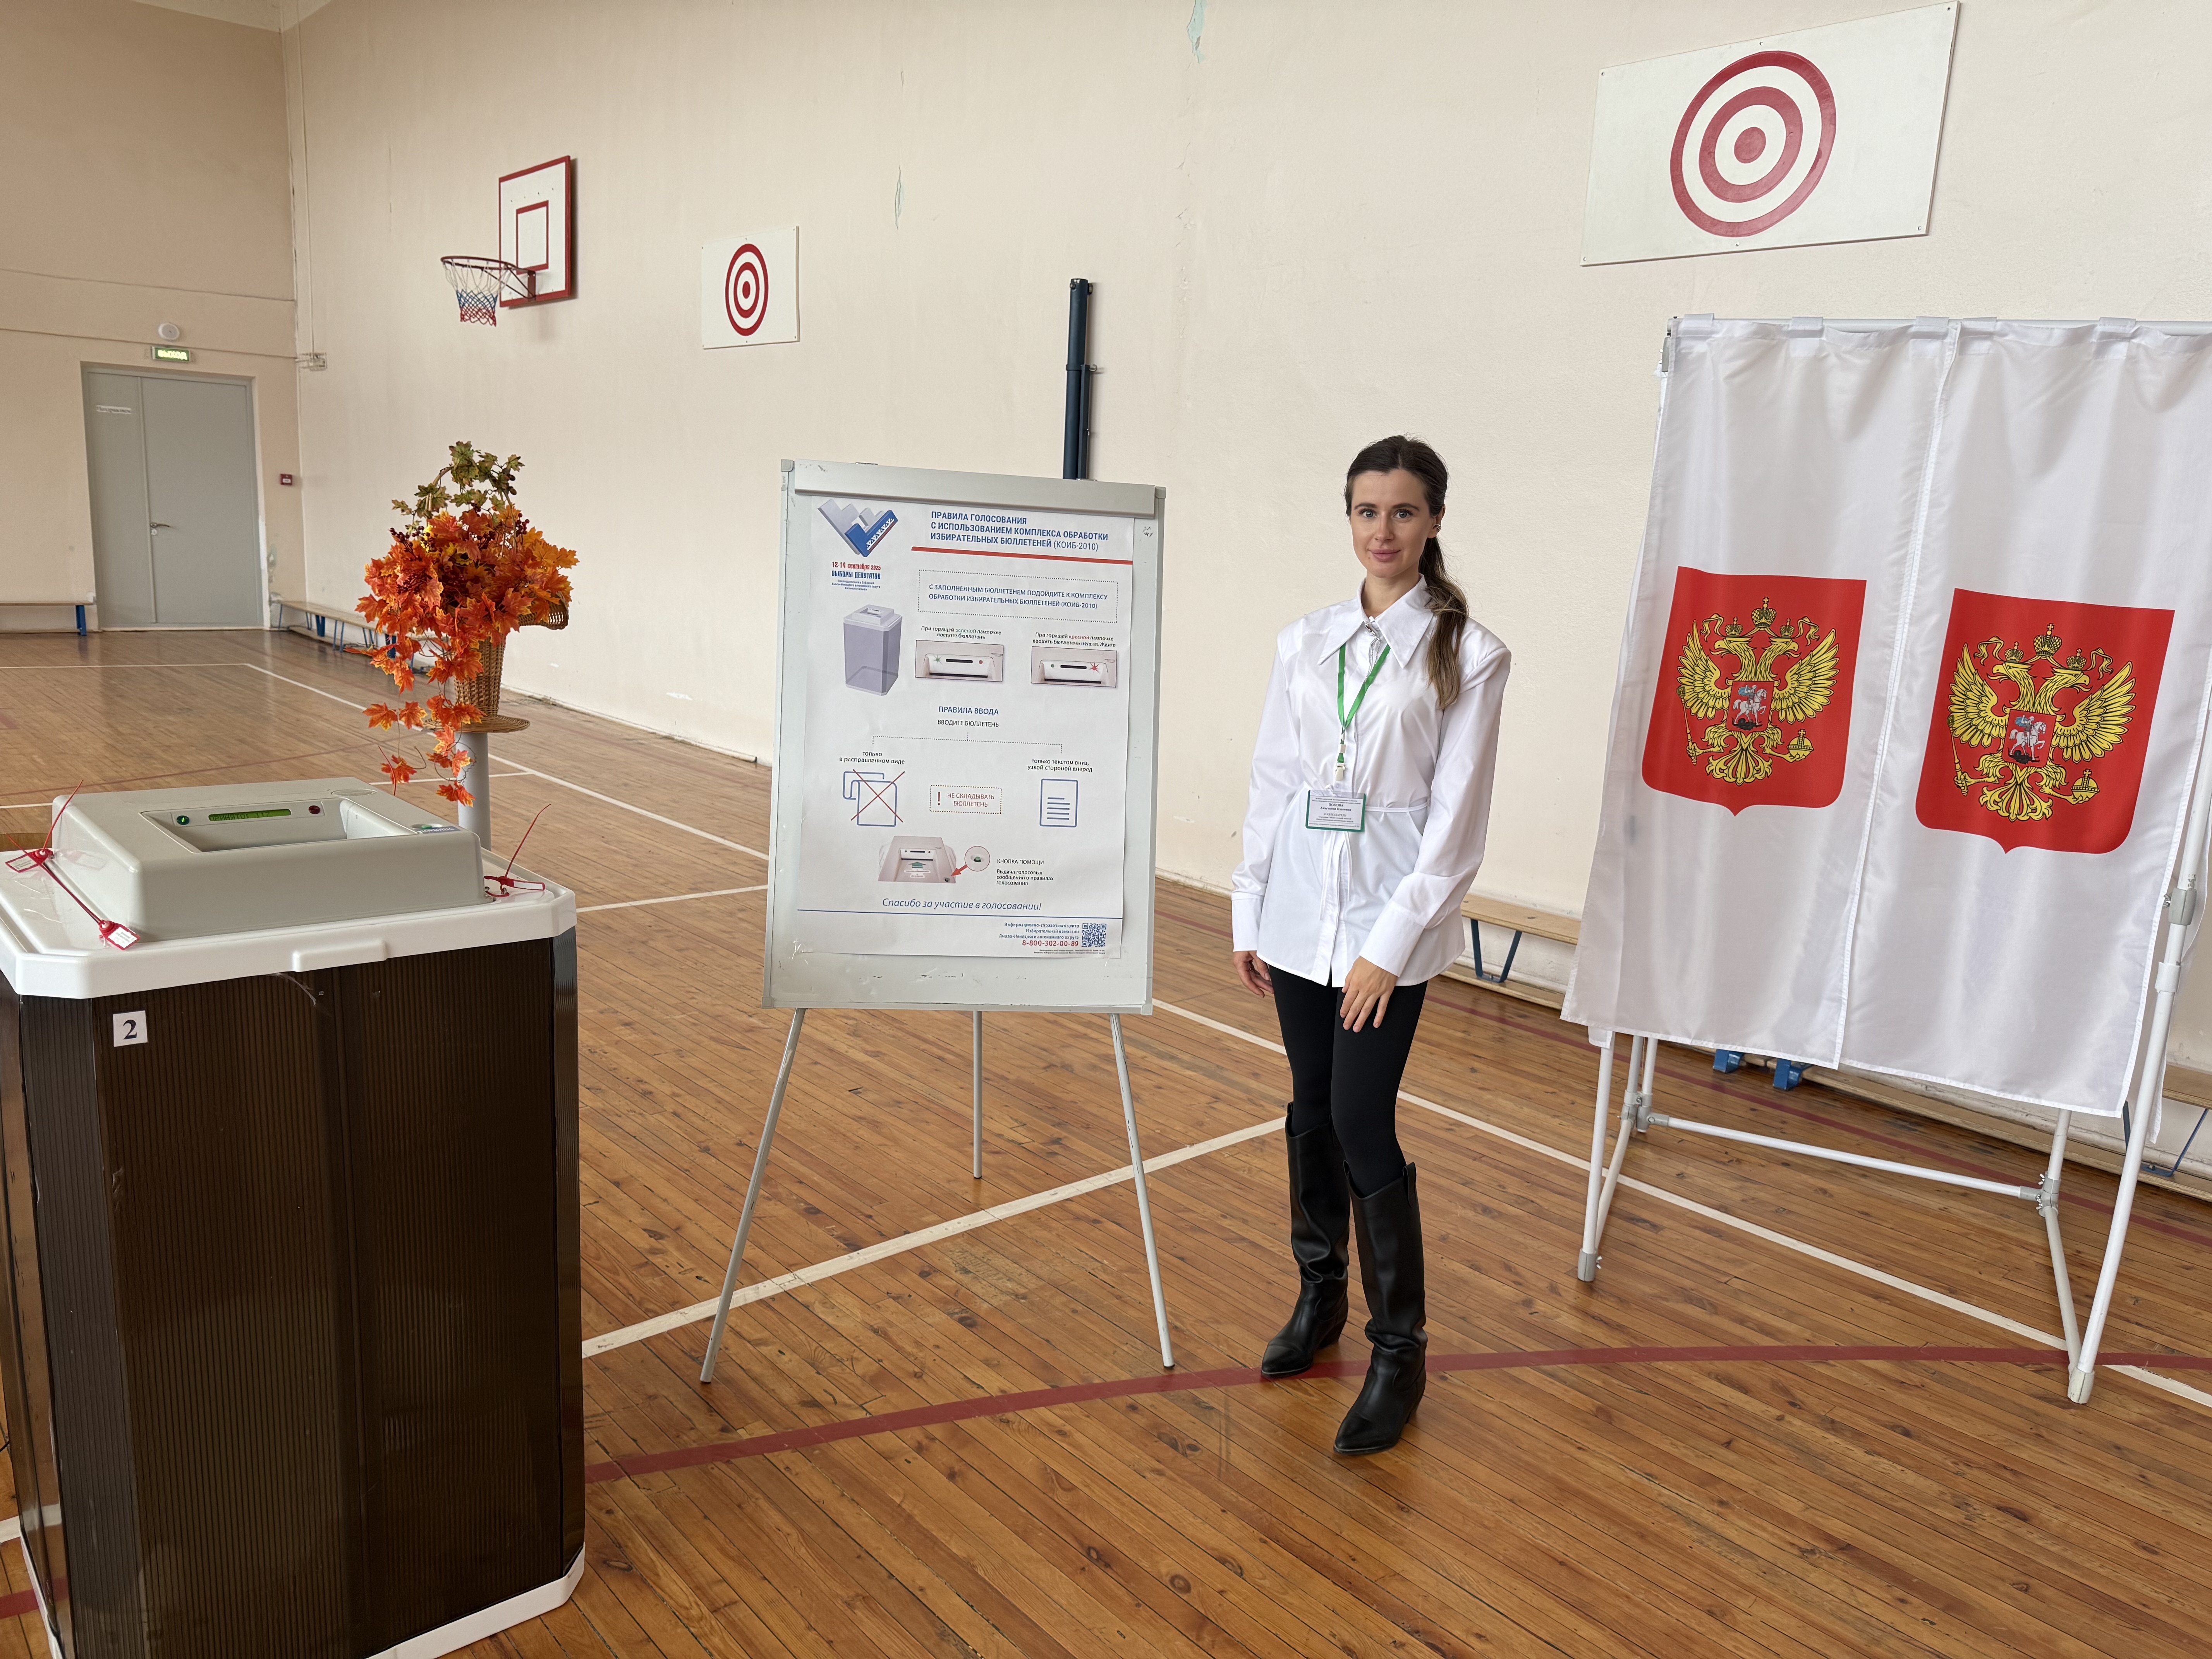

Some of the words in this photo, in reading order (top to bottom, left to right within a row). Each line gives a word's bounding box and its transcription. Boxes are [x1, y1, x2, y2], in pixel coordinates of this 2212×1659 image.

[158, 350, 187, 360] ВЫХОД
[931, 511, 968, 520] ПРАВИЛА
[970, 514, 1027, 524] ГОЛОСОВАНИЯ
[938, 522, 1012, 534] ИСПОЛЬЗОВАНИЕМ
[1014, 527, 1061, 538] КОМПЛЕКСА
[1063, 531, 1108, 540] ОБРАБОТКИ
[931, 532, 998, 544] ИЗБИРАТЕЛЬНЫХ
[1000, 537, 1051, 547] БЮЛЛЕТЕНЕЙ
[1054, 540, 1098, 552] (КОИБ-2010)
[967, 596, 1018, 604] ИЗБИРАТЕЛЬНЫХ
[974, 708, 999, 716] ВВОДА
[882, 898, 921, 907] Спасибо
[934, 901, 974, 910] участие
[123, 1019, 137, 1040] 2
